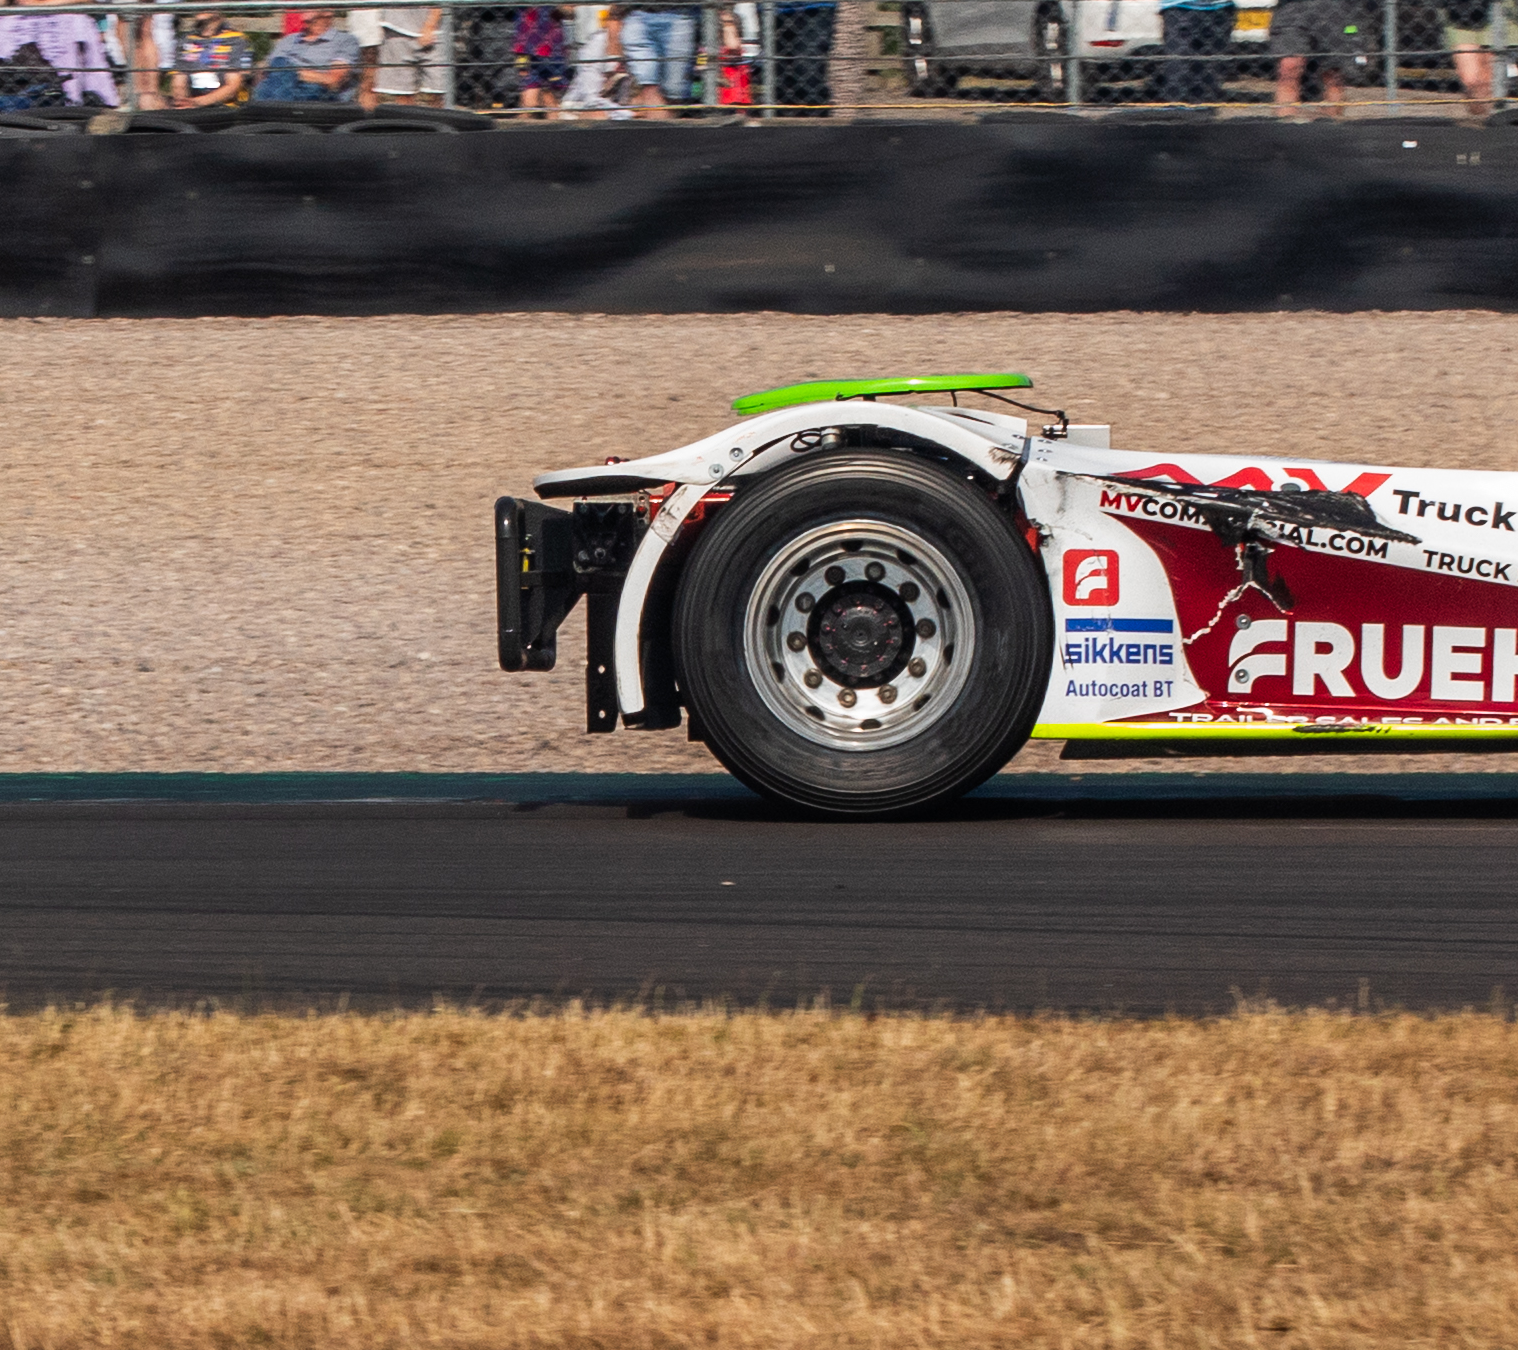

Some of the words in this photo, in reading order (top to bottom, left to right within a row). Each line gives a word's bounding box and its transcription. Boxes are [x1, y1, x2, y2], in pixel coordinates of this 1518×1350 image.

[1391, 488, 1517, 532] Truck
[1421, 548, 1511, 582] TRUCK
[1065, 637, 1174, 666] sikkens
[1065, 679, 1150, 698] Autocoat
[1153, 680, 1174, 698] BT
